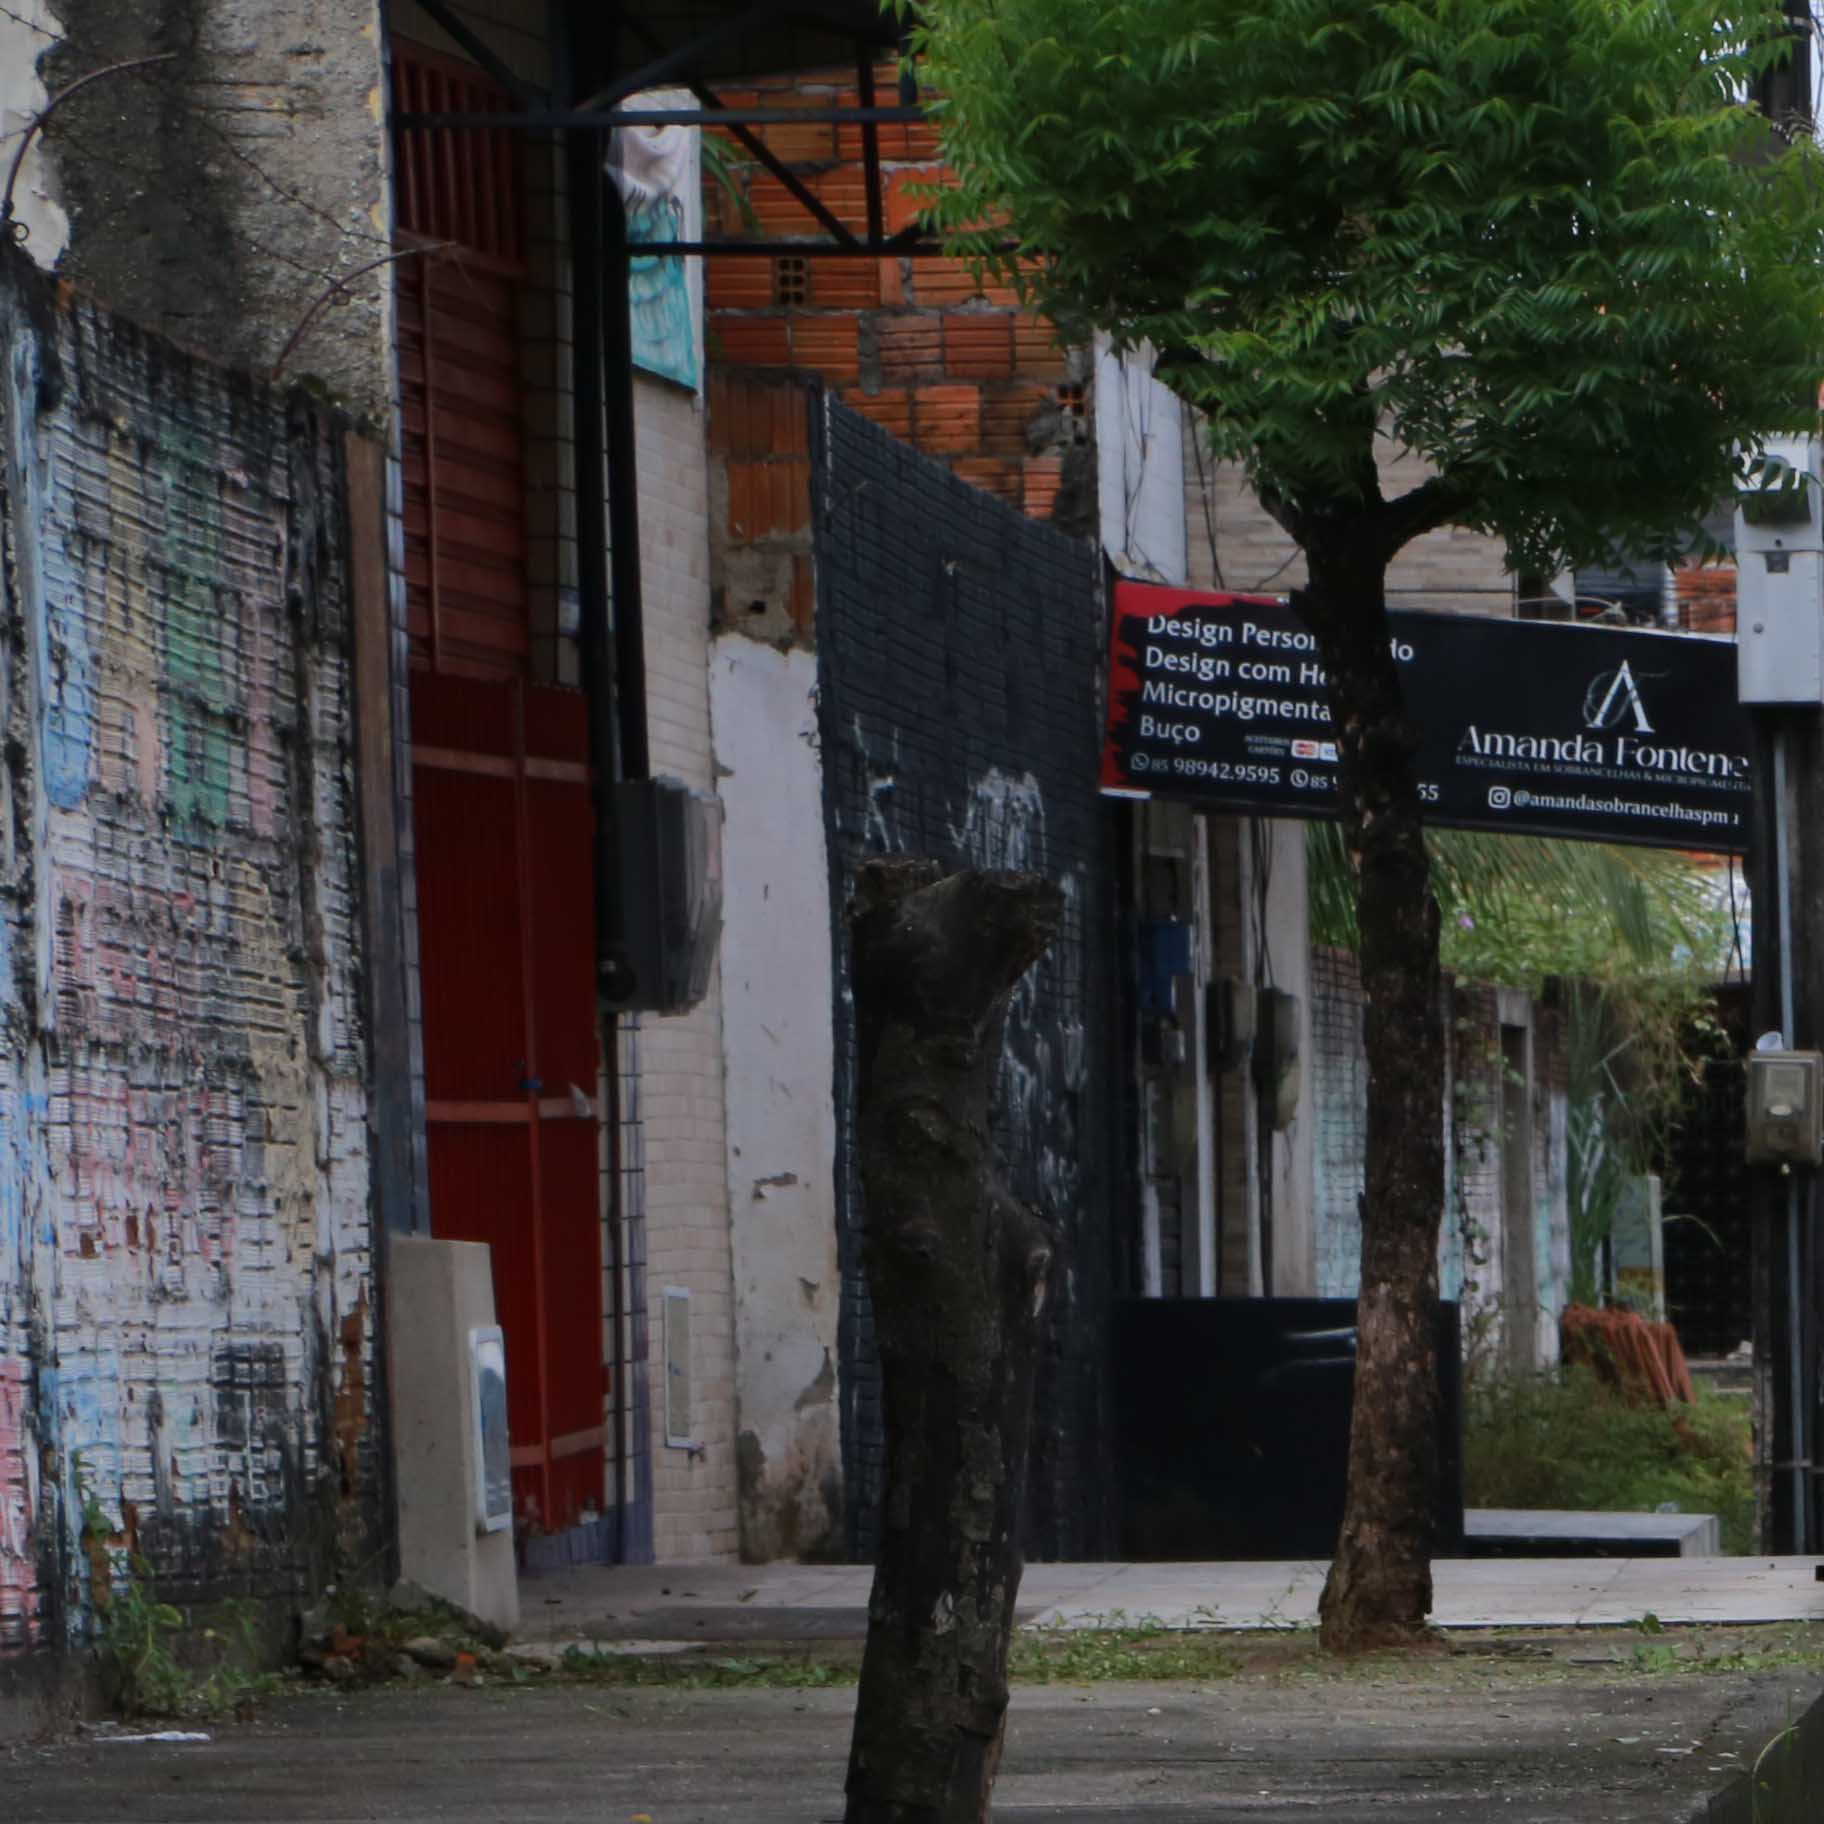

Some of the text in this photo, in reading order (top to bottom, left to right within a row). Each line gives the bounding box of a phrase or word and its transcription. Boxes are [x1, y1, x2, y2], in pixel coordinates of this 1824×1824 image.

[1148, 614, 1232, 647] Design
[1145, 646, 1230, 680] Design
[1238, 662, 1291, 683] com
[1142, 680, 1332, 722] Micropigmenta
[1140, 714, 1201, 744] Buço
[1457, 725, 1749, 778] Amanda Fontene
[1173, 757, 1281, 784] 98942.9595
[1310, 775, 1329, 790] 85
[1416, 783, 1439, 801] 55
